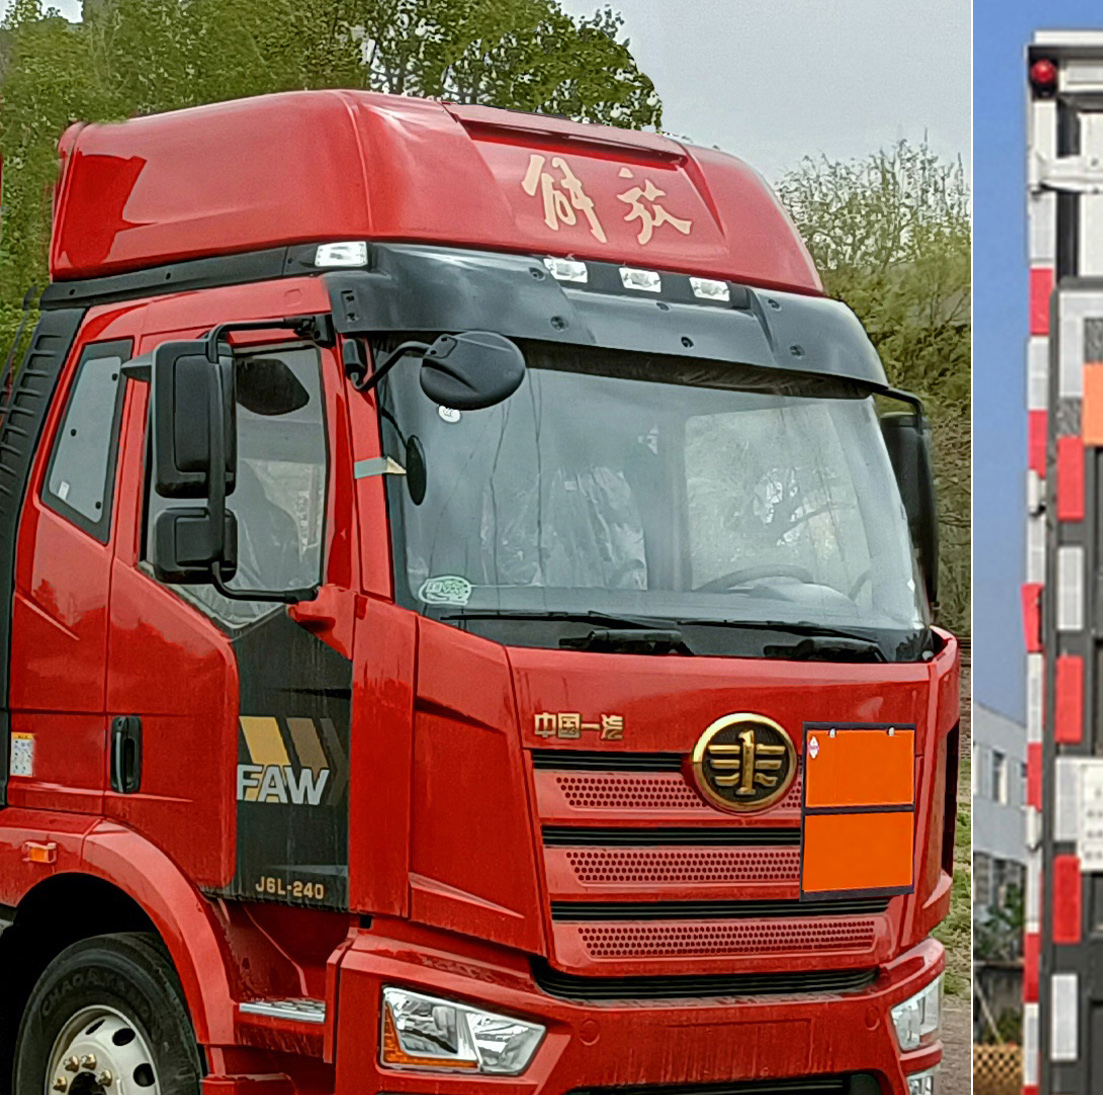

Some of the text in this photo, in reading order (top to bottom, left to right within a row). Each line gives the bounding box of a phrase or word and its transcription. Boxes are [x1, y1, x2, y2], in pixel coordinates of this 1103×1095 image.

[534, 712, 624, 740] 中国一汽
[236, 763, 329, 805] FAW
[255, 876, 324, 900] J6L-240
